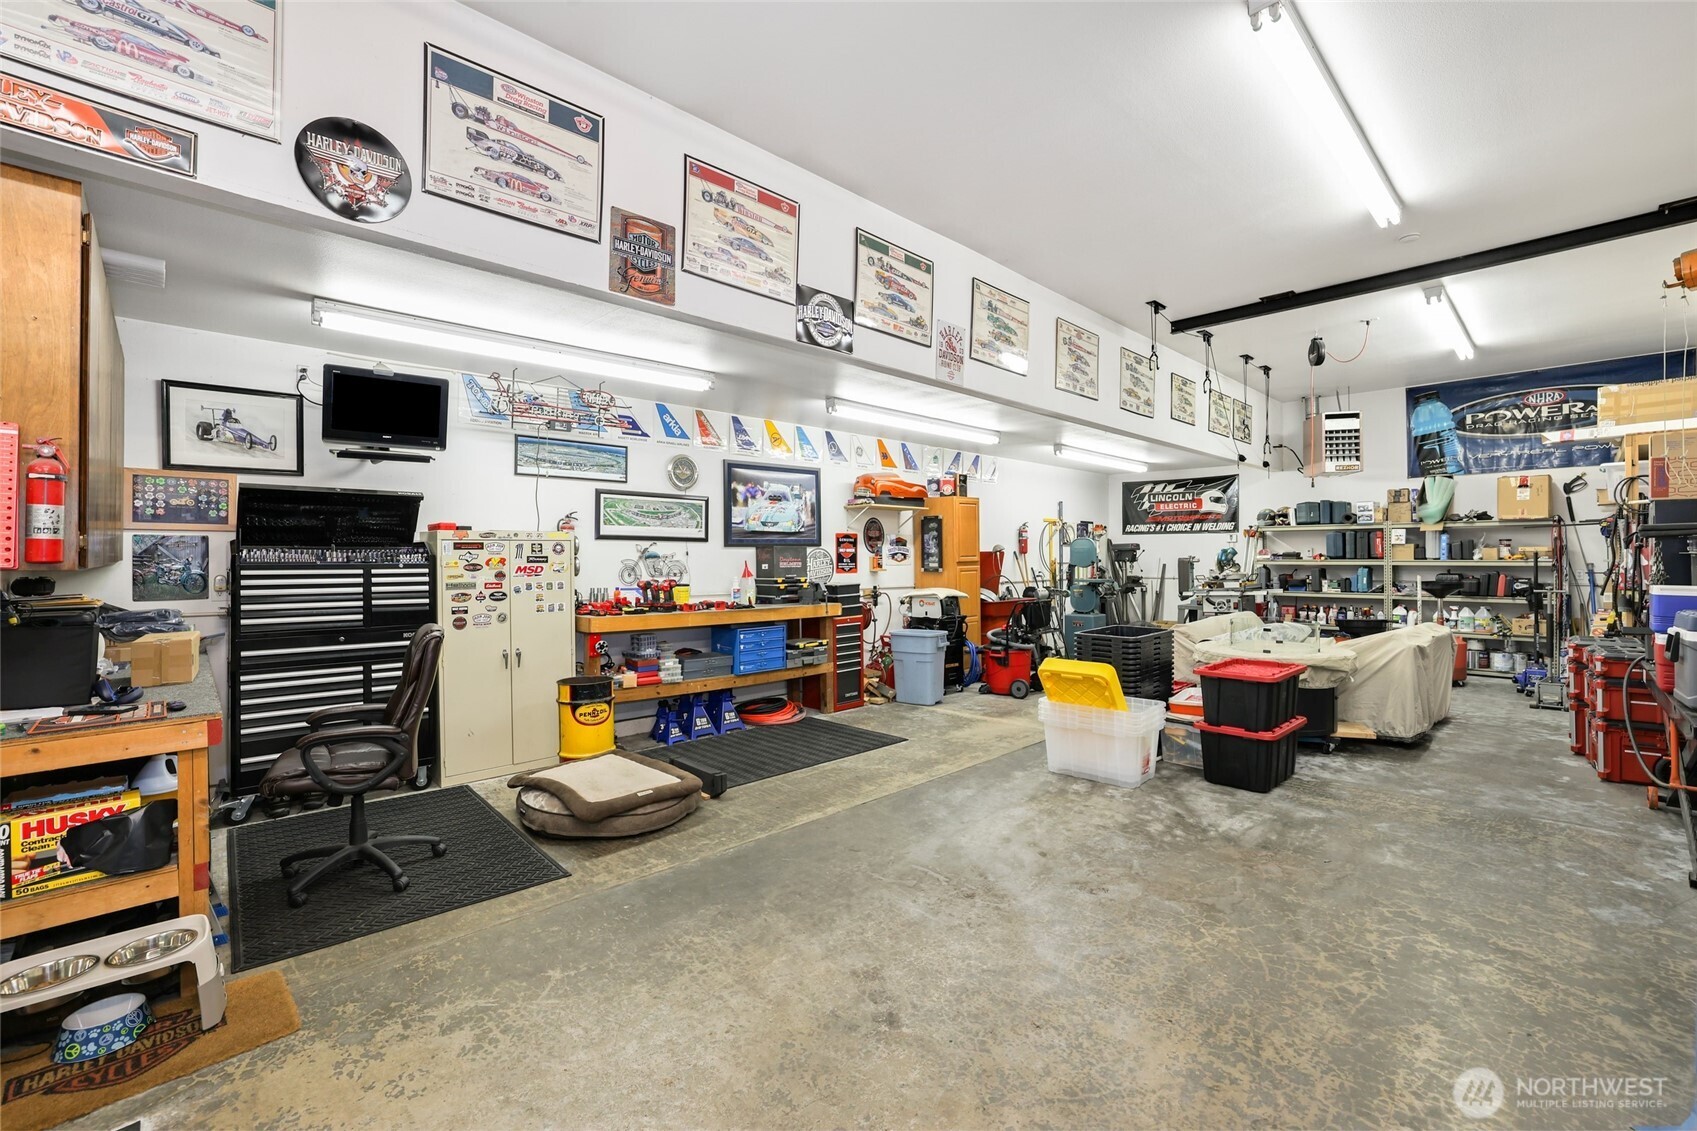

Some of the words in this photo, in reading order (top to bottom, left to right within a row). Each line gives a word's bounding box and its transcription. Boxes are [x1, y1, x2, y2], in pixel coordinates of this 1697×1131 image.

[130, 133, 177, 152] HARLEY-DAVIDSON
[305, 131, 402, 172] HARLEY-DAVIDSON
[614, 239, 672, 264] HARLEY-DAVIDSON
[797, 305, 852, 334] HARLEY-DAVIDSON
[938, 348, 964, 364] DAVIDSON
[1528, 392, 1560, 403] NHRA
[1466, 421, 1502, 430] DRAG
[1509, 416, 1563, 426] RACING
[1150, 493, 1193, 502] LINCOLN
[1159, 502, 1198, 510] ELECTRIC
[1125, 523, 1156, 532] RACING'S
[1166, 523, 1192, 532] CHOICE
[1192, 523, 1201, 531] IN
[1201, 522, 1236, 531] WELDING
[515, 566, 544, 574] MSD
[579, 708, 608, 717] PENNZOIL
[22, 804, 126, 840] HUSKY
[16, 887, 29, 896] 50
[30, 884, 49, 893] BAGS
